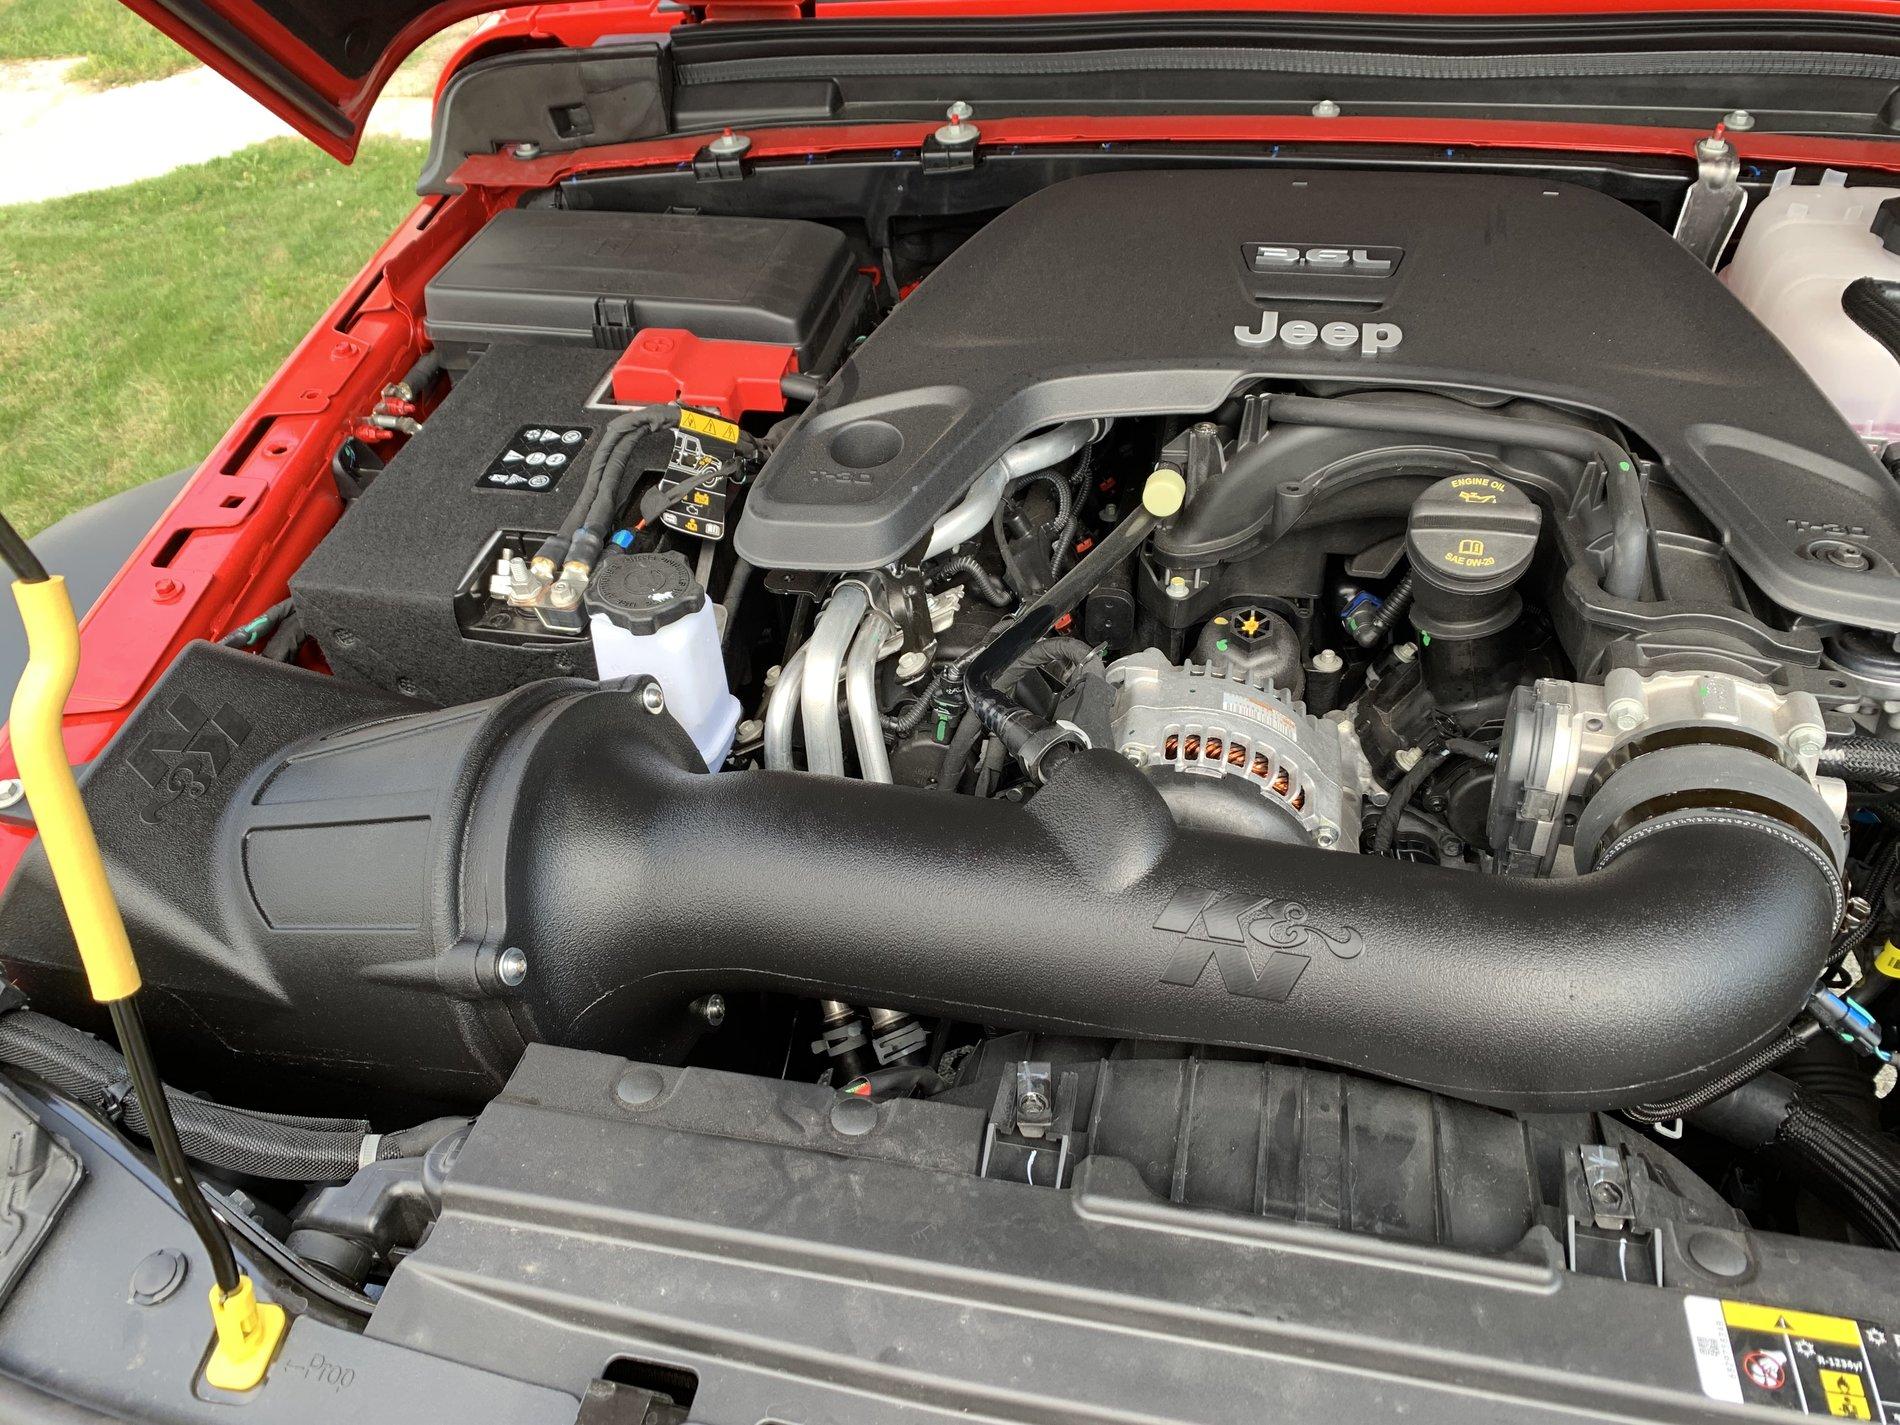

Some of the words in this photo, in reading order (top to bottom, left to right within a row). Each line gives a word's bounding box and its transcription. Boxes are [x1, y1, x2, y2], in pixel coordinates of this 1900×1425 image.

[1255, 246, 1391, 269] 3.6L
[1234, 311, 1403, 357] Jeep
[1451, 477, 1490, 488] ENGINE
[1490, 480, 1506, 492] OIL
[1445, 552, 1466, 565] SAE
[304, 1352, 355, 1394] Prop
